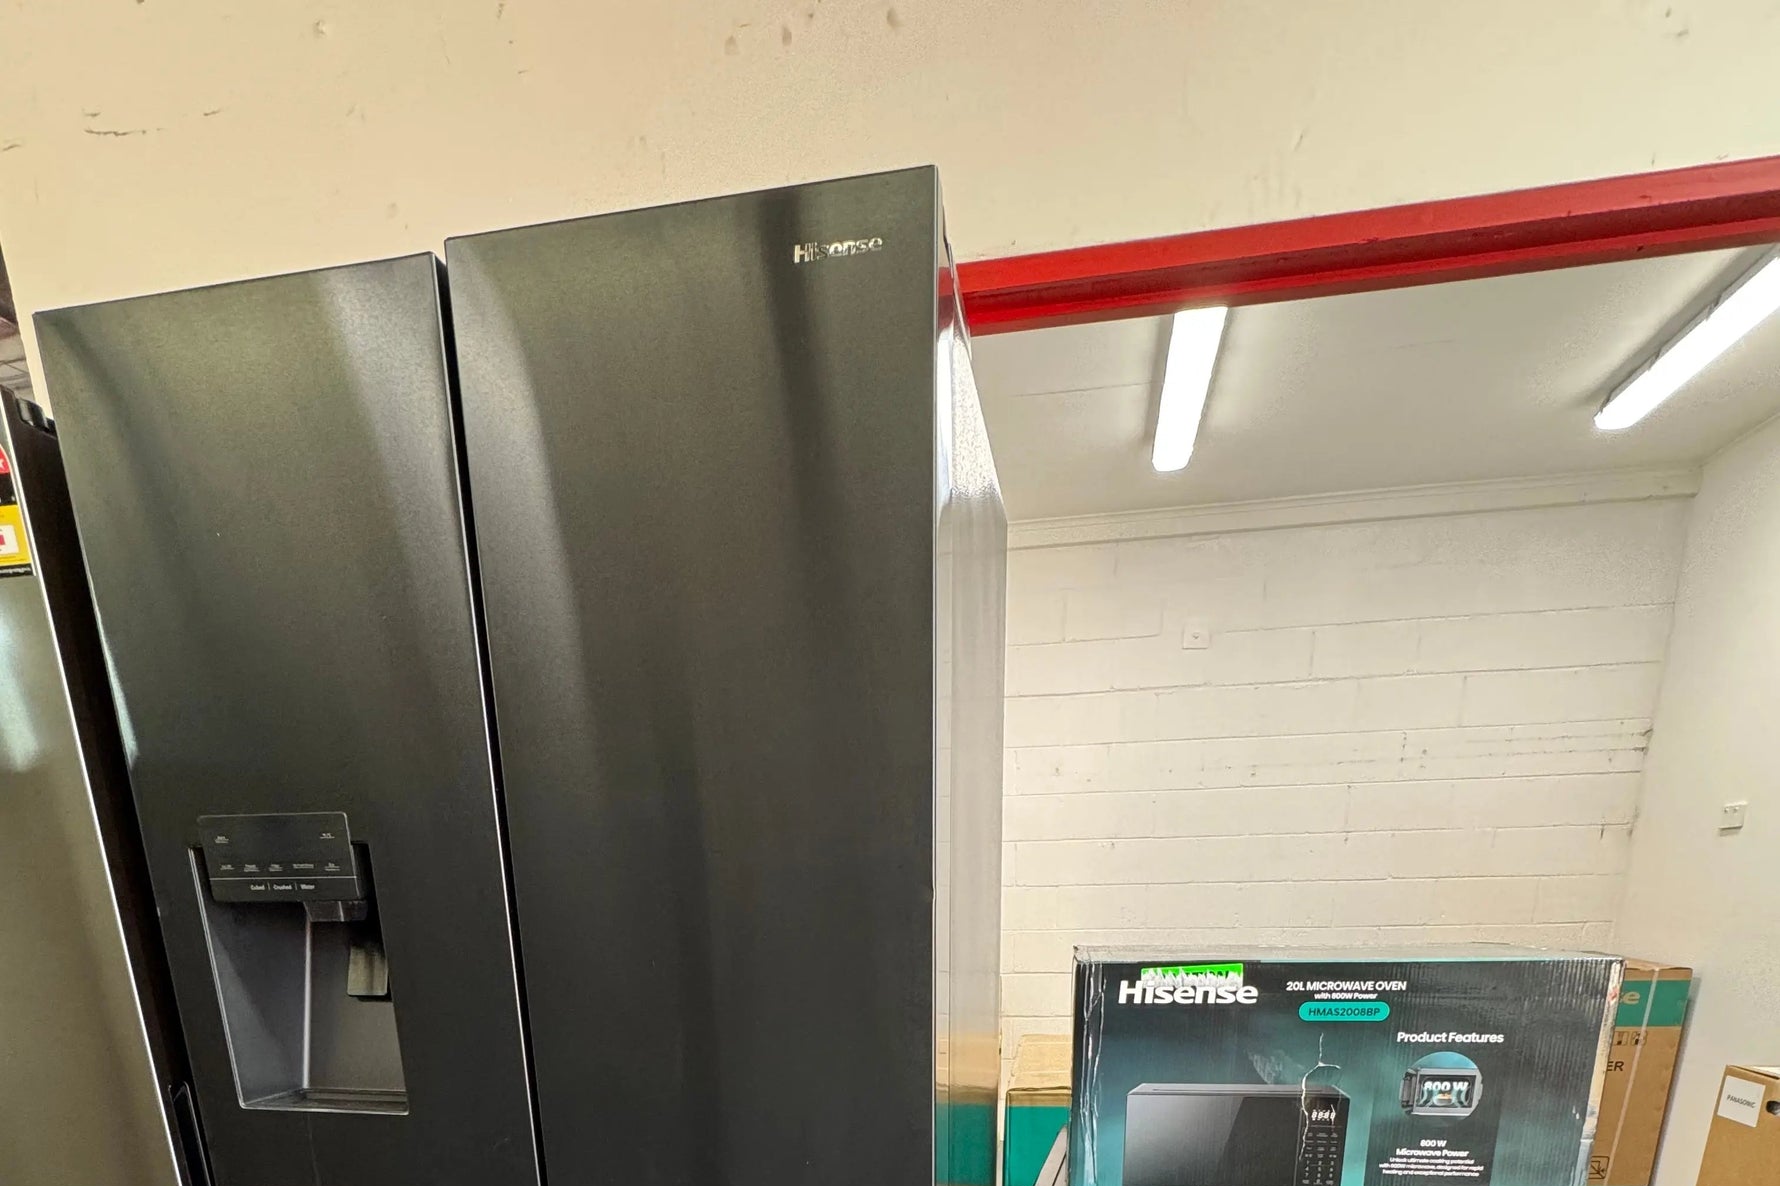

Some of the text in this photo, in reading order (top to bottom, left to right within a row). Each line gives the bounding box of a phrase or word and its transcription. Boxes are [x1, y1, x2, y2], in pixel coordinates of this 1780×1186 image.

[793, 237, 883, 264] Hisense
[1285, 980, 1407, 992] 20L MICROWAVE OVEN
[1118, 980, 1259, 1004] Hisense
[1314, 992, 1331, 1000] with
[1353, 992, 1378, 1000] Power
[1308, 1007, 1381, 1017] HMAS2008BP
[1396, 1031, 1505, 1043] Product Features
[1452, 1081, 1469, 1091] W
[1420, 1139, 1447, 1147] 800 W
[1395, 1148, 1470, 1158] Microwave Power
